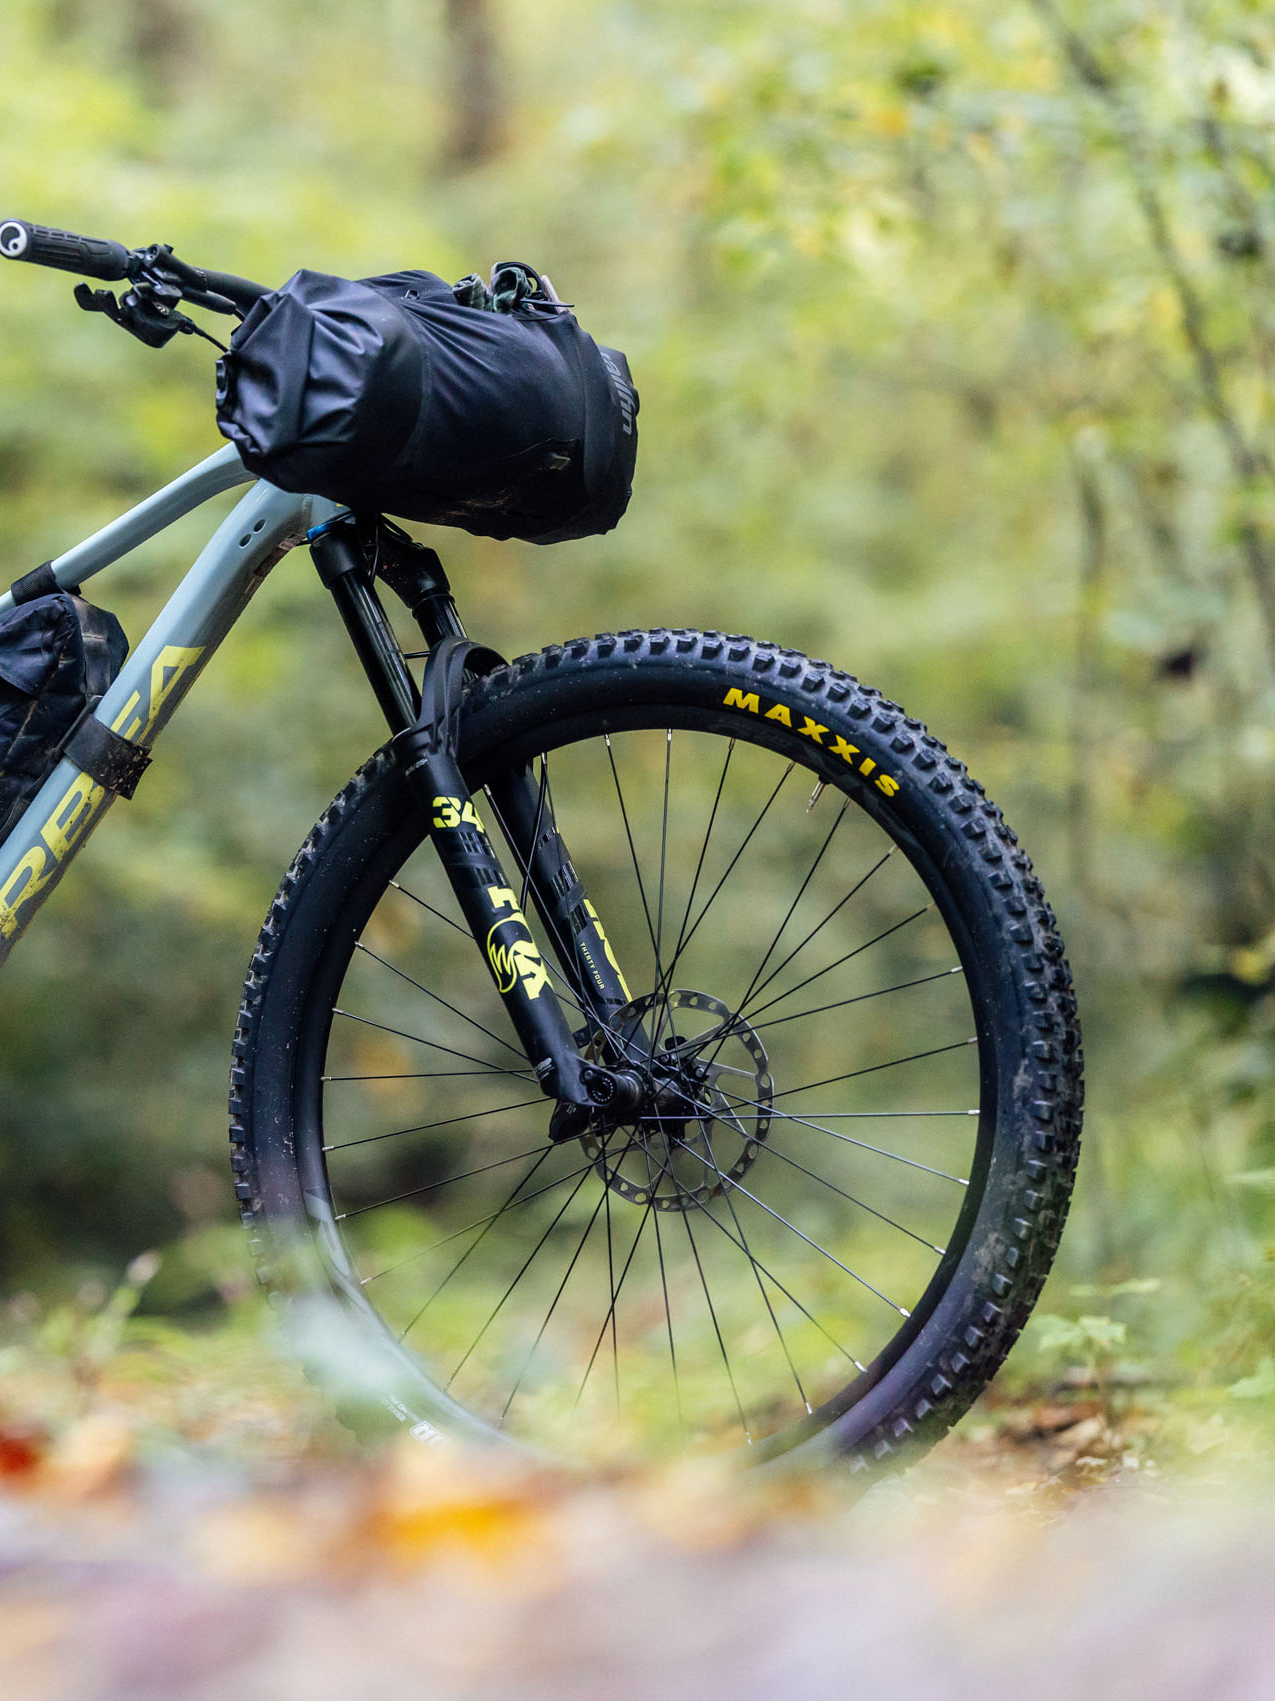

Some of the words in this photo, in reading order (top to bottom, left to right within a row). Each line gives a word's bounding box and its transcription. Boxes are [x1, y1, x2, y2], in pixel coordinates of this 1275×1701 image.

[723, 687, 900, 797] MAXXIS
[433, 796, 485, 834] 34
[580, 942, 596, 972] THIRTY
[593, 969, 605, 990] FOUR
